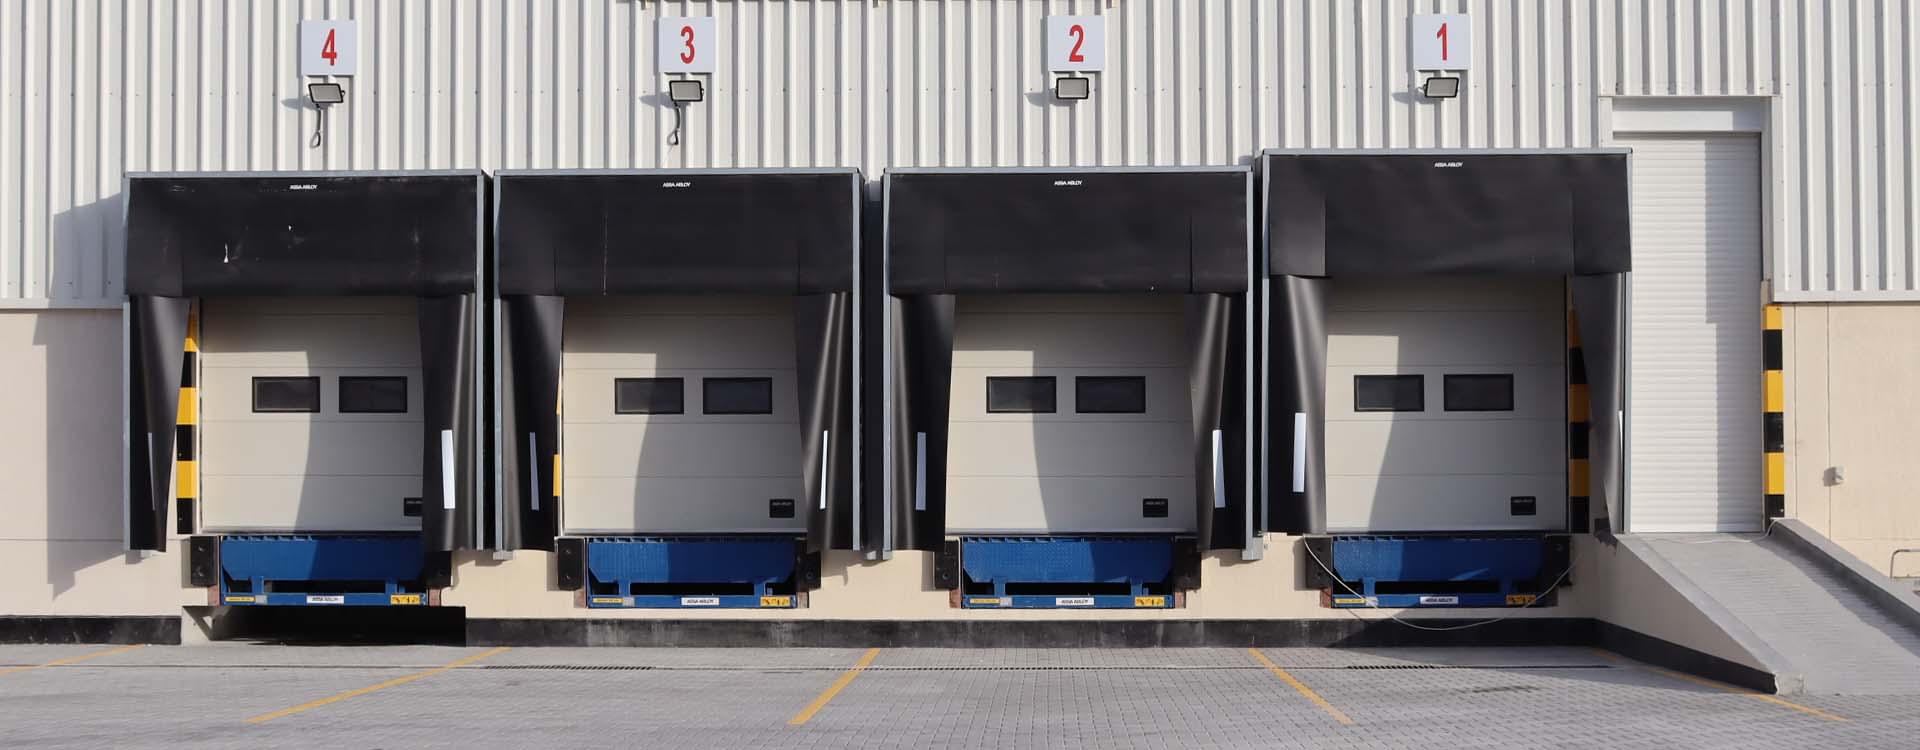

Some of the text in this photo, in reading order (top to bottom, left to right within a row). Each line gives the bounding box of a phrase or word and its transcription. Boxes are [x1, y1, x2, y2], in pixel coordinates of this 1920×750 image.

[320, 29, 337, 65] 4
[680, 25, 695, 65] 3
[1071, 25, 1086, 63] 2
[1436, 24, 1448, 60] 1
